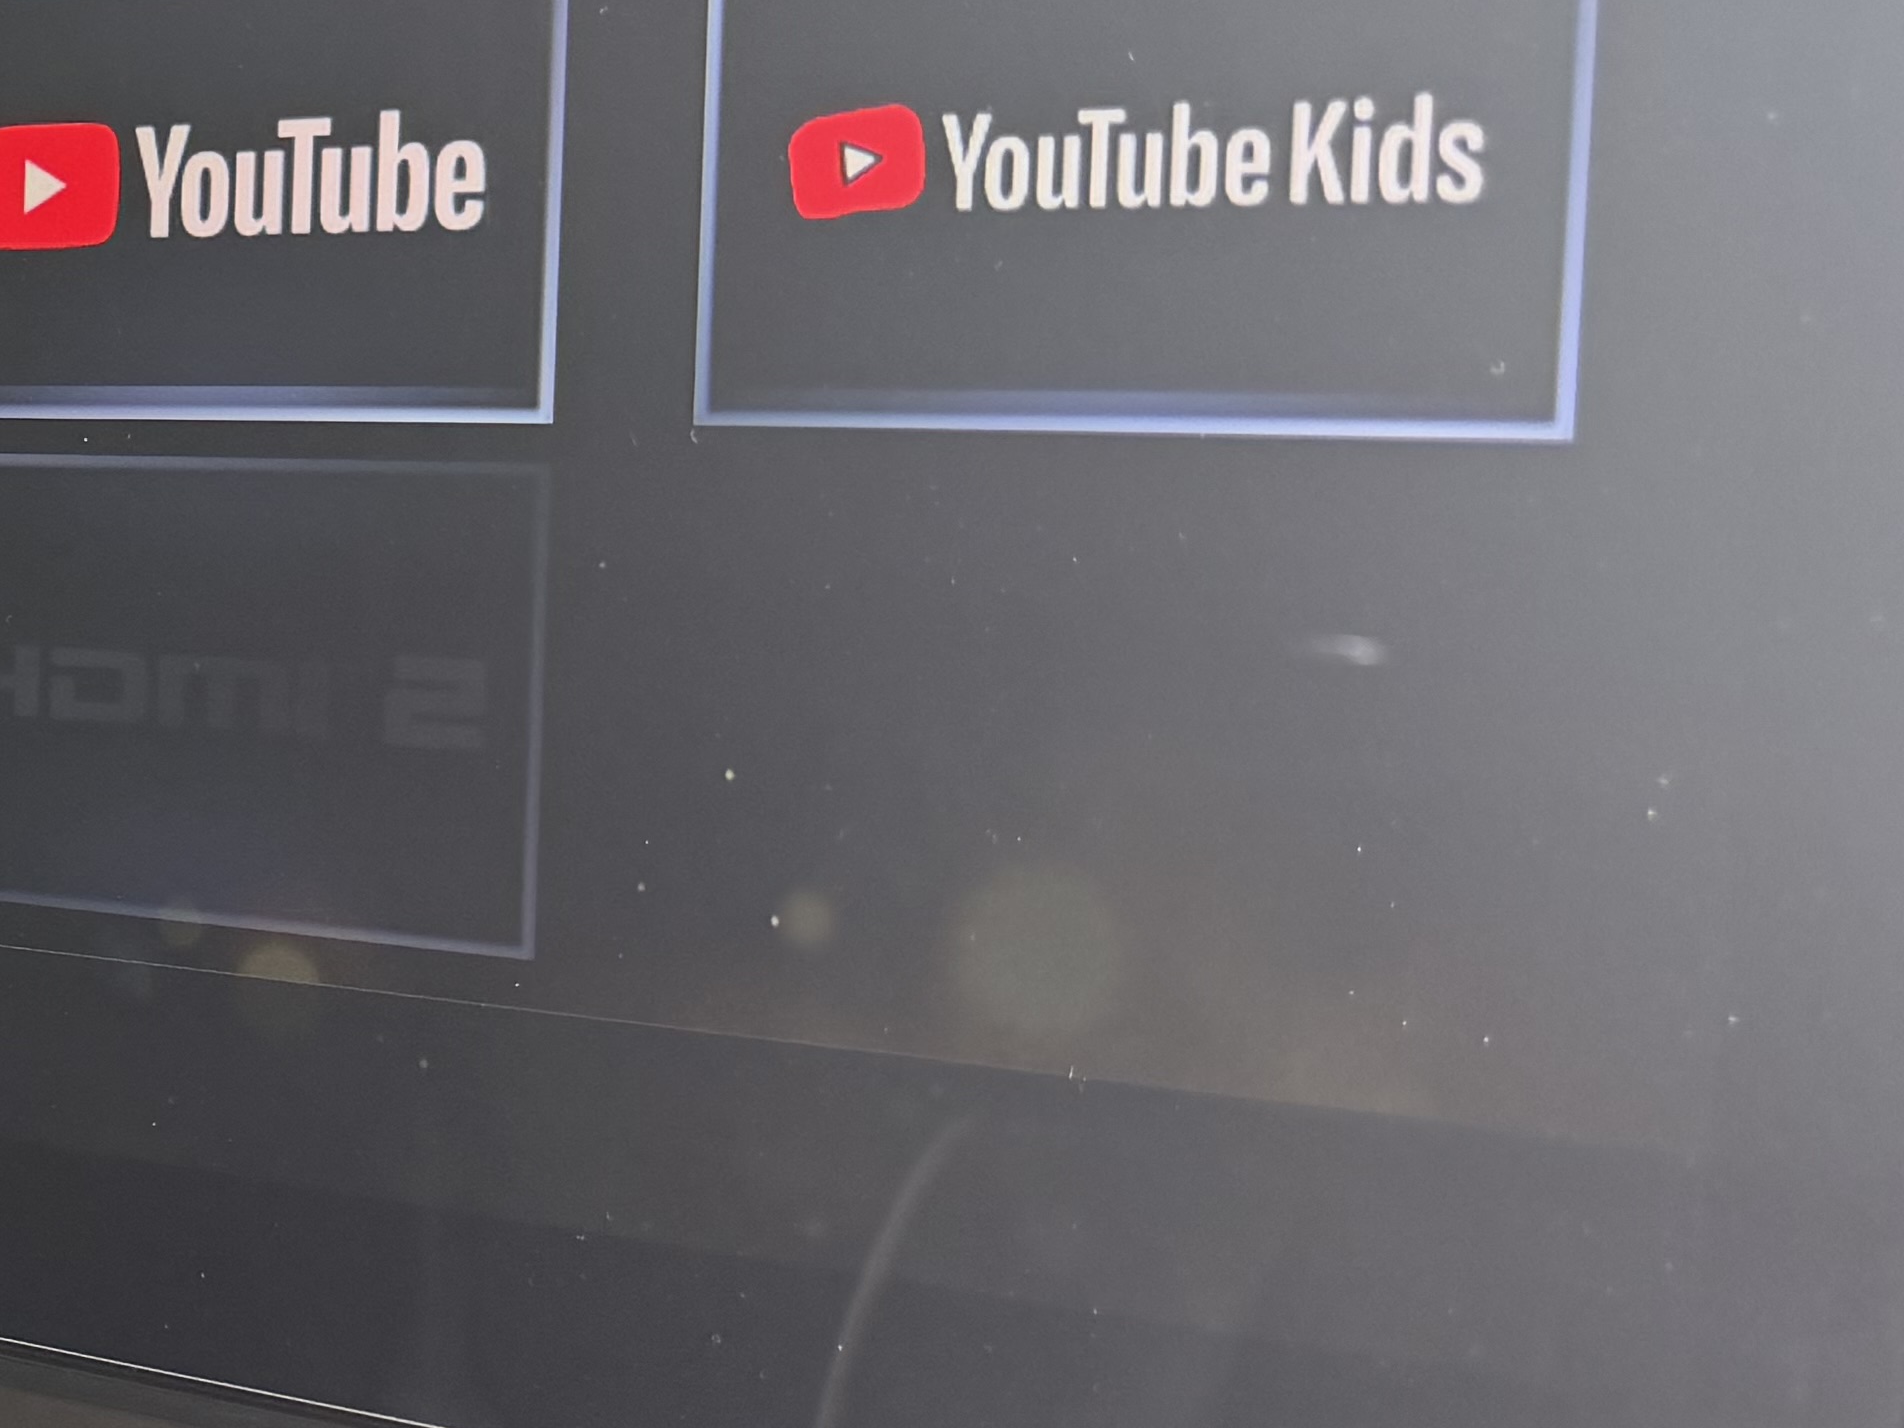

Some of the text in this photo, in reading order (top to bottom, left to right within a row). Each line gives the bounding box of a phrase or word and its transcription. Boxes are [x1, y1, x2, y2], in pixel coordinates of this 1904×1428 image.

[134, 108, 487, 239] YouTube
[941, 90, 1486, 213] YouTube Kids
[384, 652, 484, 750] 2
